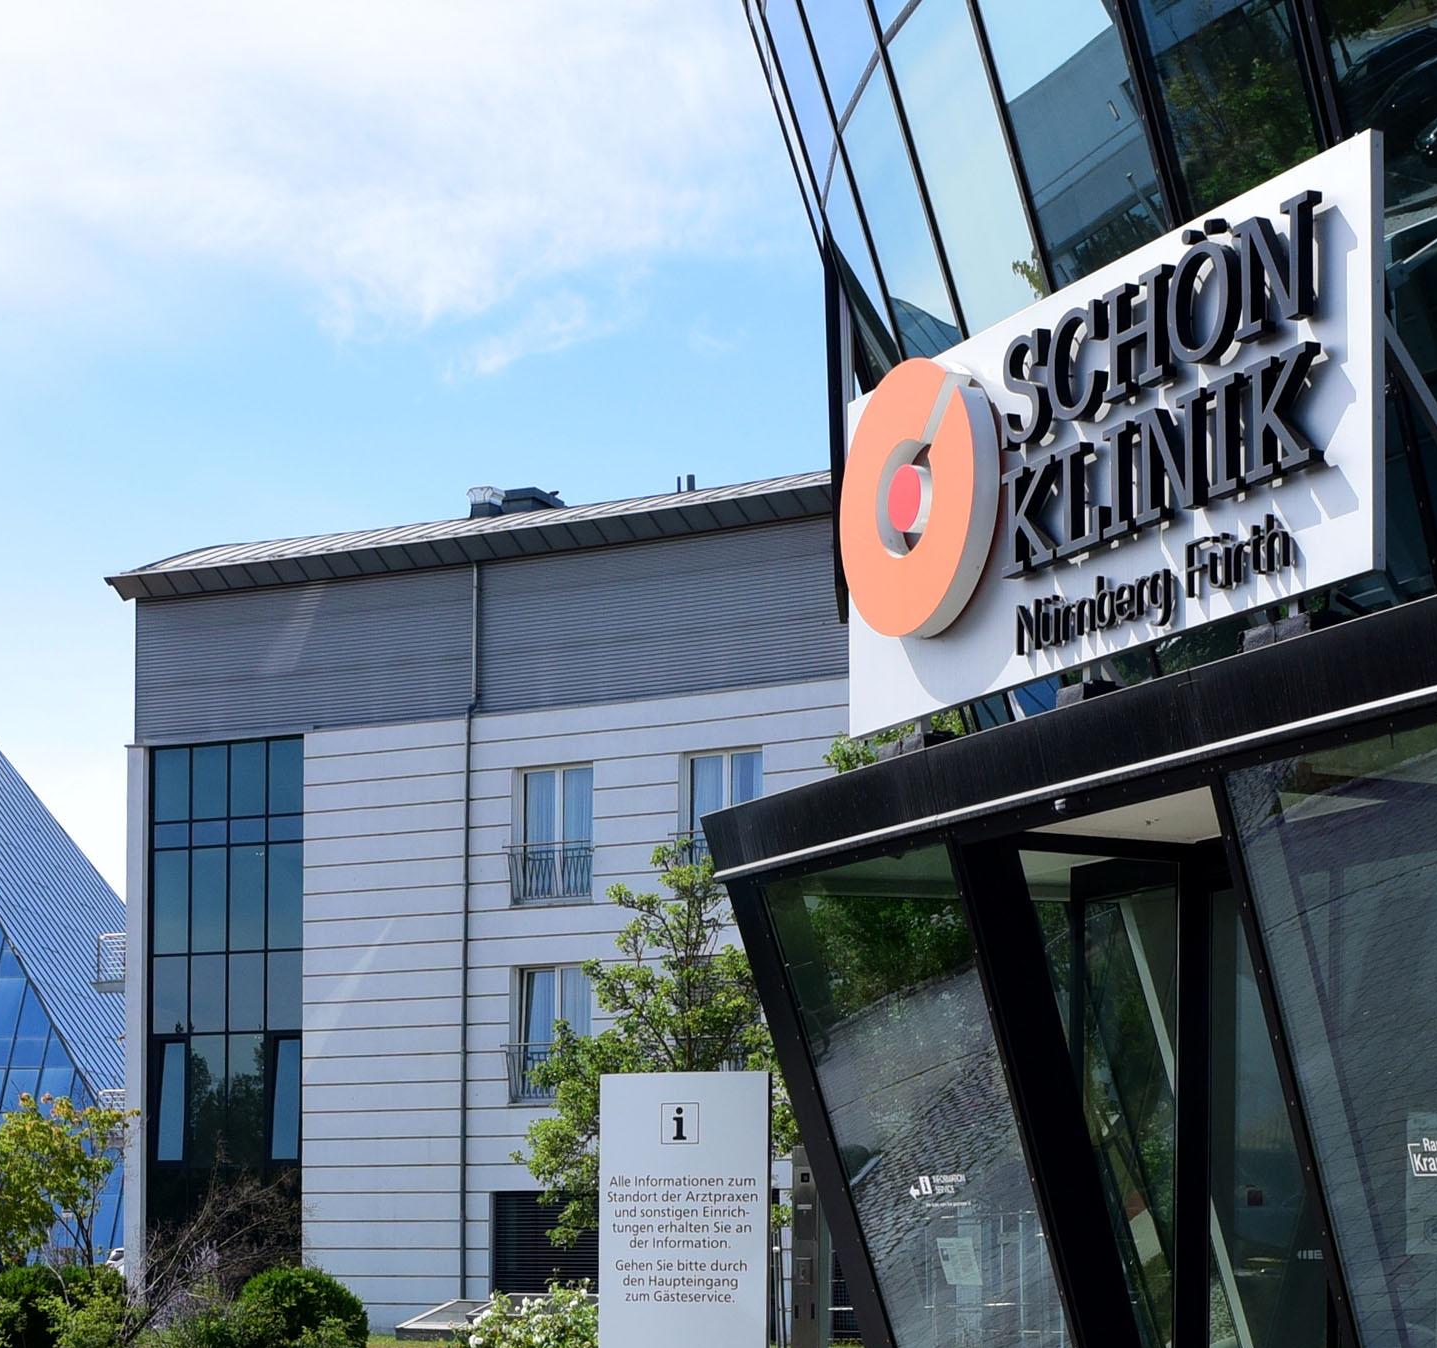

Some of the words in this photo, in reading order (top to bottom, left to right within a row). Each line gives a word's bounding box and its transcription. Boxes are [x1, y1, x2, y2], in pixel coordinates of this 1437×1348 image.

[1002, 190, 1322, 450] SCHÖN
[1001, 341, 1324, 580] KLINIK
[1016, 567, 1173, 656] Nürnberg
[1184, 513, 1291, 598] Fürth
[610, 1175, 632, 1188] Alle
[634, 1175, 724, 1188] Informationen
[728, 1178, 756, 1187] zum
[607, 1190, 658, 1203] Standort
[661, 1190, 681, 1203] der
[685, 1190, 758, 1205] Arztpraxen
[615, 1206, 637, 1218] und
[640, 1207, 700, 1221] sonstigen
[702, 1206, 750, 1218] Einrich-
[612, 1223, 654, 1237] tungen
[657, 1222, 710, 1234] erhalten
[713, 1221, 732, 1234] Sie
[735, 1225, 752, 1234] an
[629, 1237, 648, 1249] der
[652, 1237, 732, 1249] Information.
[615, 1259, 653, 1272] Gehen
[657, 1259, 673, 1272] Sie
[677, 1259, 706, 1272] bitte
[710, 1260, 748, 1272] durch
[622, 1275, 645, 1287] den
[648, 1275, 739, 1290] Haupteingang
[625, 1293, 650, 1302] zum
[653, 1290, 735, 1304] Gästeservice.
